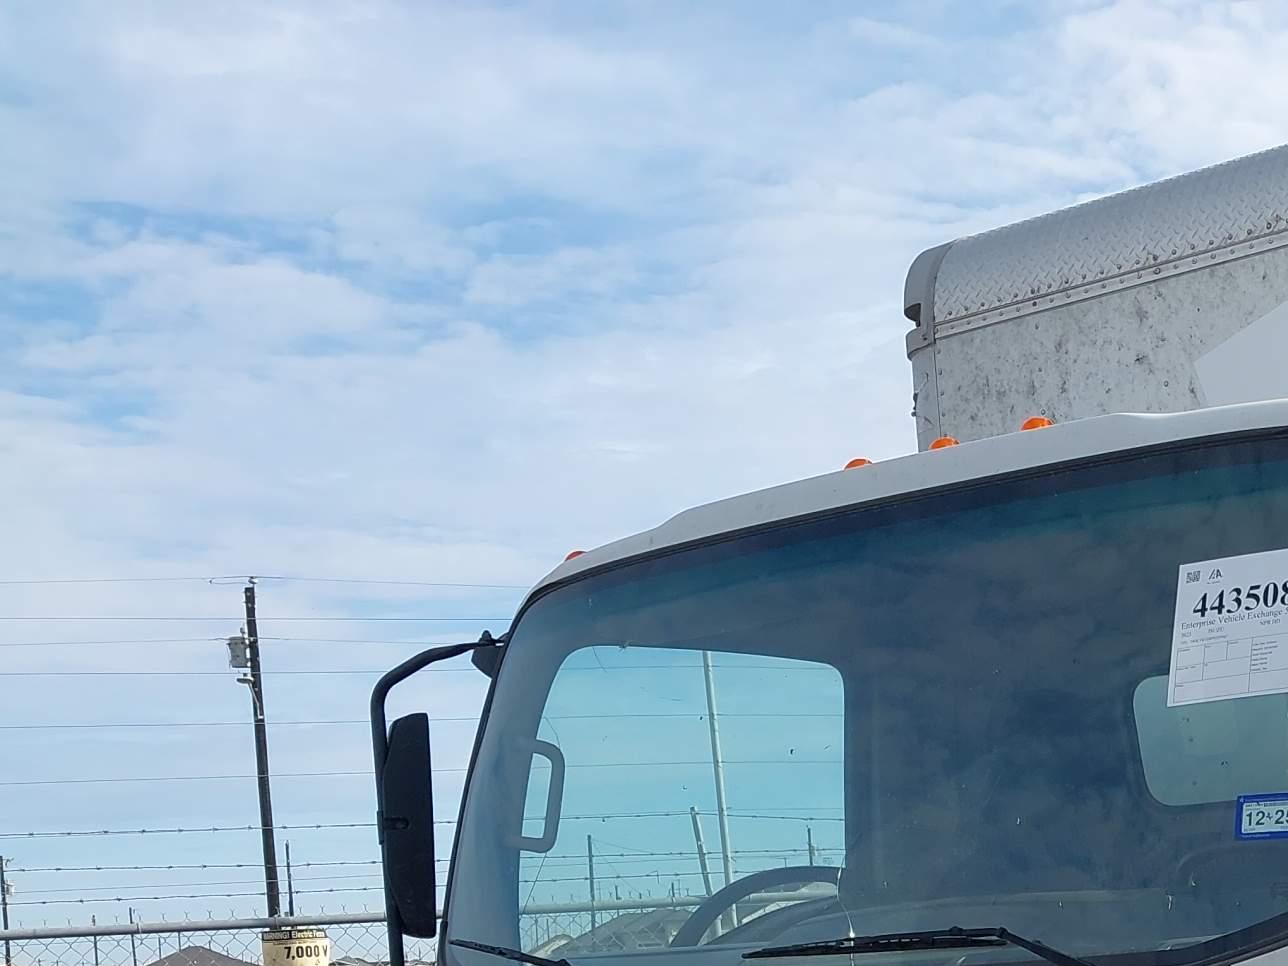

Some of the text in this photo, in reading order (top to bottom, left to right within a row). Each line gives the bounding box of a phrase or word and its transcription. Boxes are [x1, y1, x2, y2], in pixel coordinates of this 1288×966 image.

[1181, 618, 1216, 630] Enterprise
[1218, 613, 1246, 624] Vehicle
[1247, 608, 1283, 620] Exchange
[1246, 810, 1266, 826] 12
[284, 945, 320, 960] 7,000
